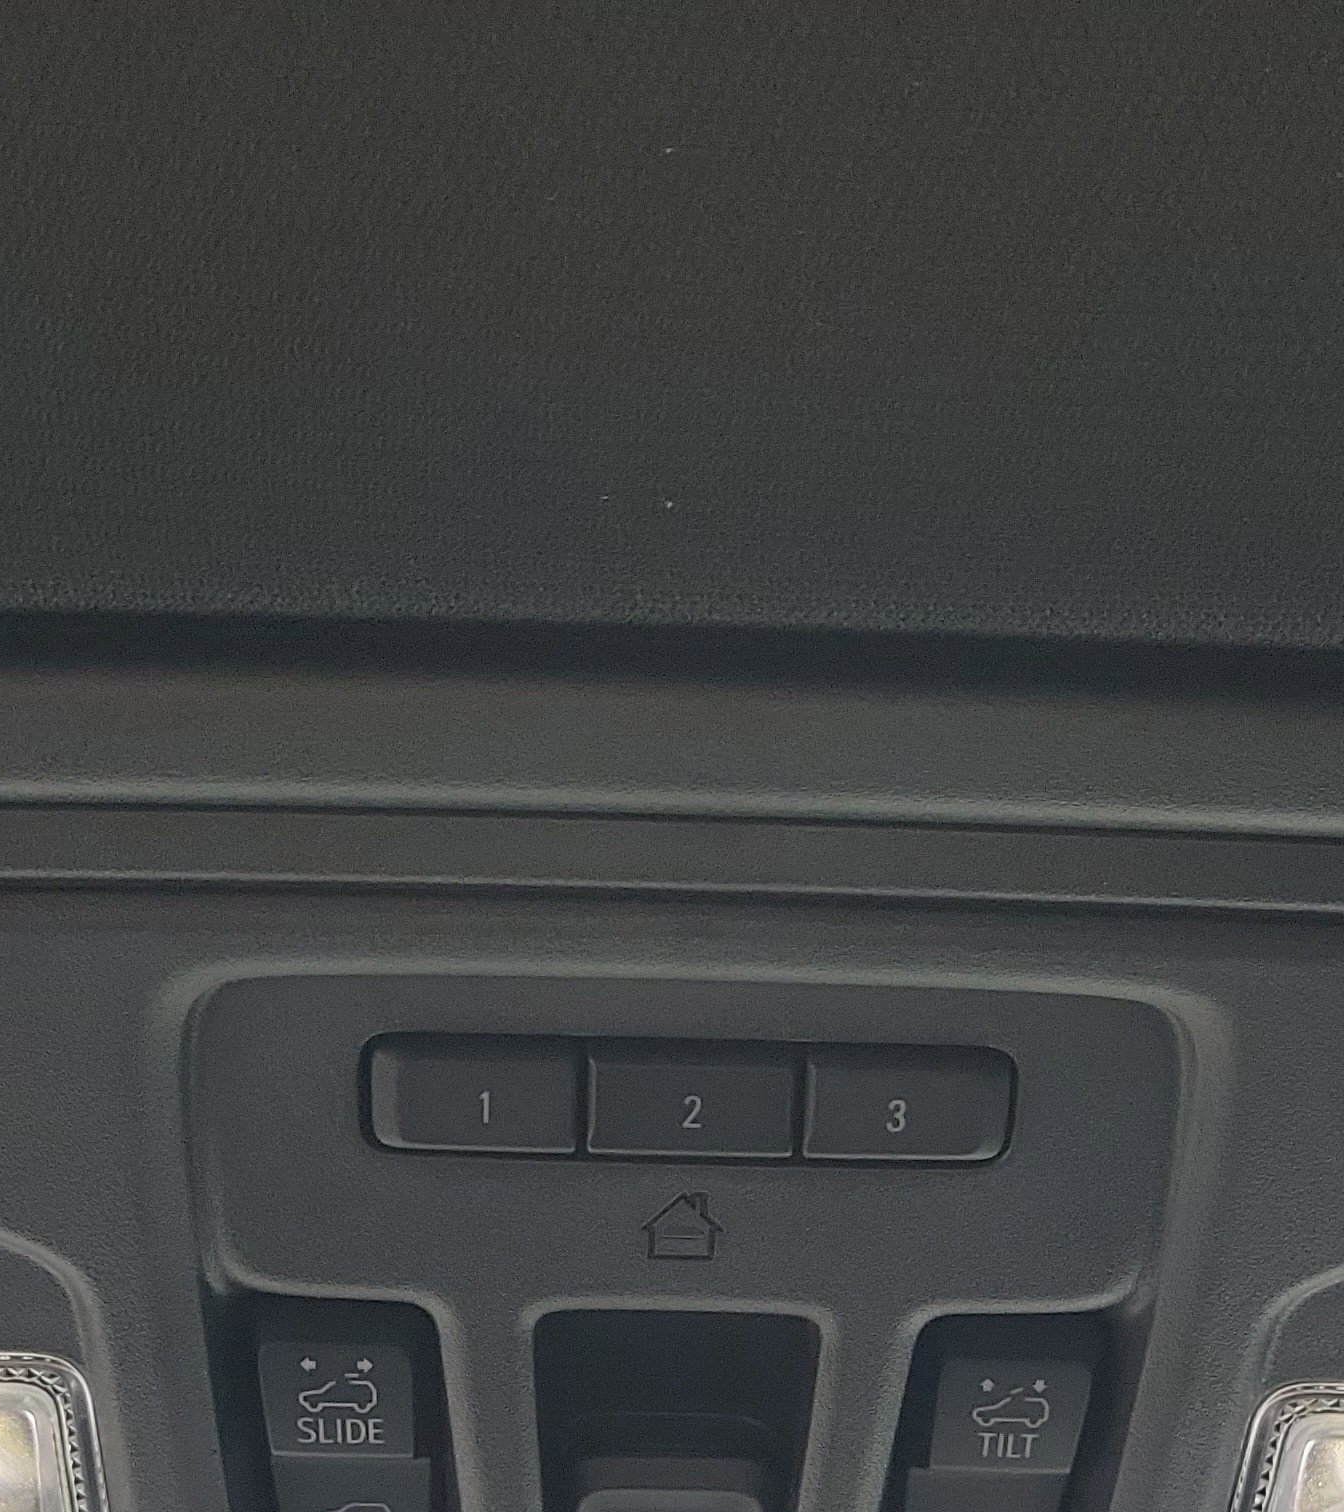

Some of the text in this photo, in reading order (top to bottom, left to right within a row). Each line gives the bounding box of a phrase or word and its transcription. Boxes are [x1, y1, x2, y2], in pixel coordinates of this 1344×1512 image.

[479, 1091, 491, 1123] 1
[683, 1096, 701, 1128] 2
[886, 1100, 906, 1131] 3
[297, 1418, 384, 1444] SLIDE
[979, 1433, 1038, 1458] TILT
